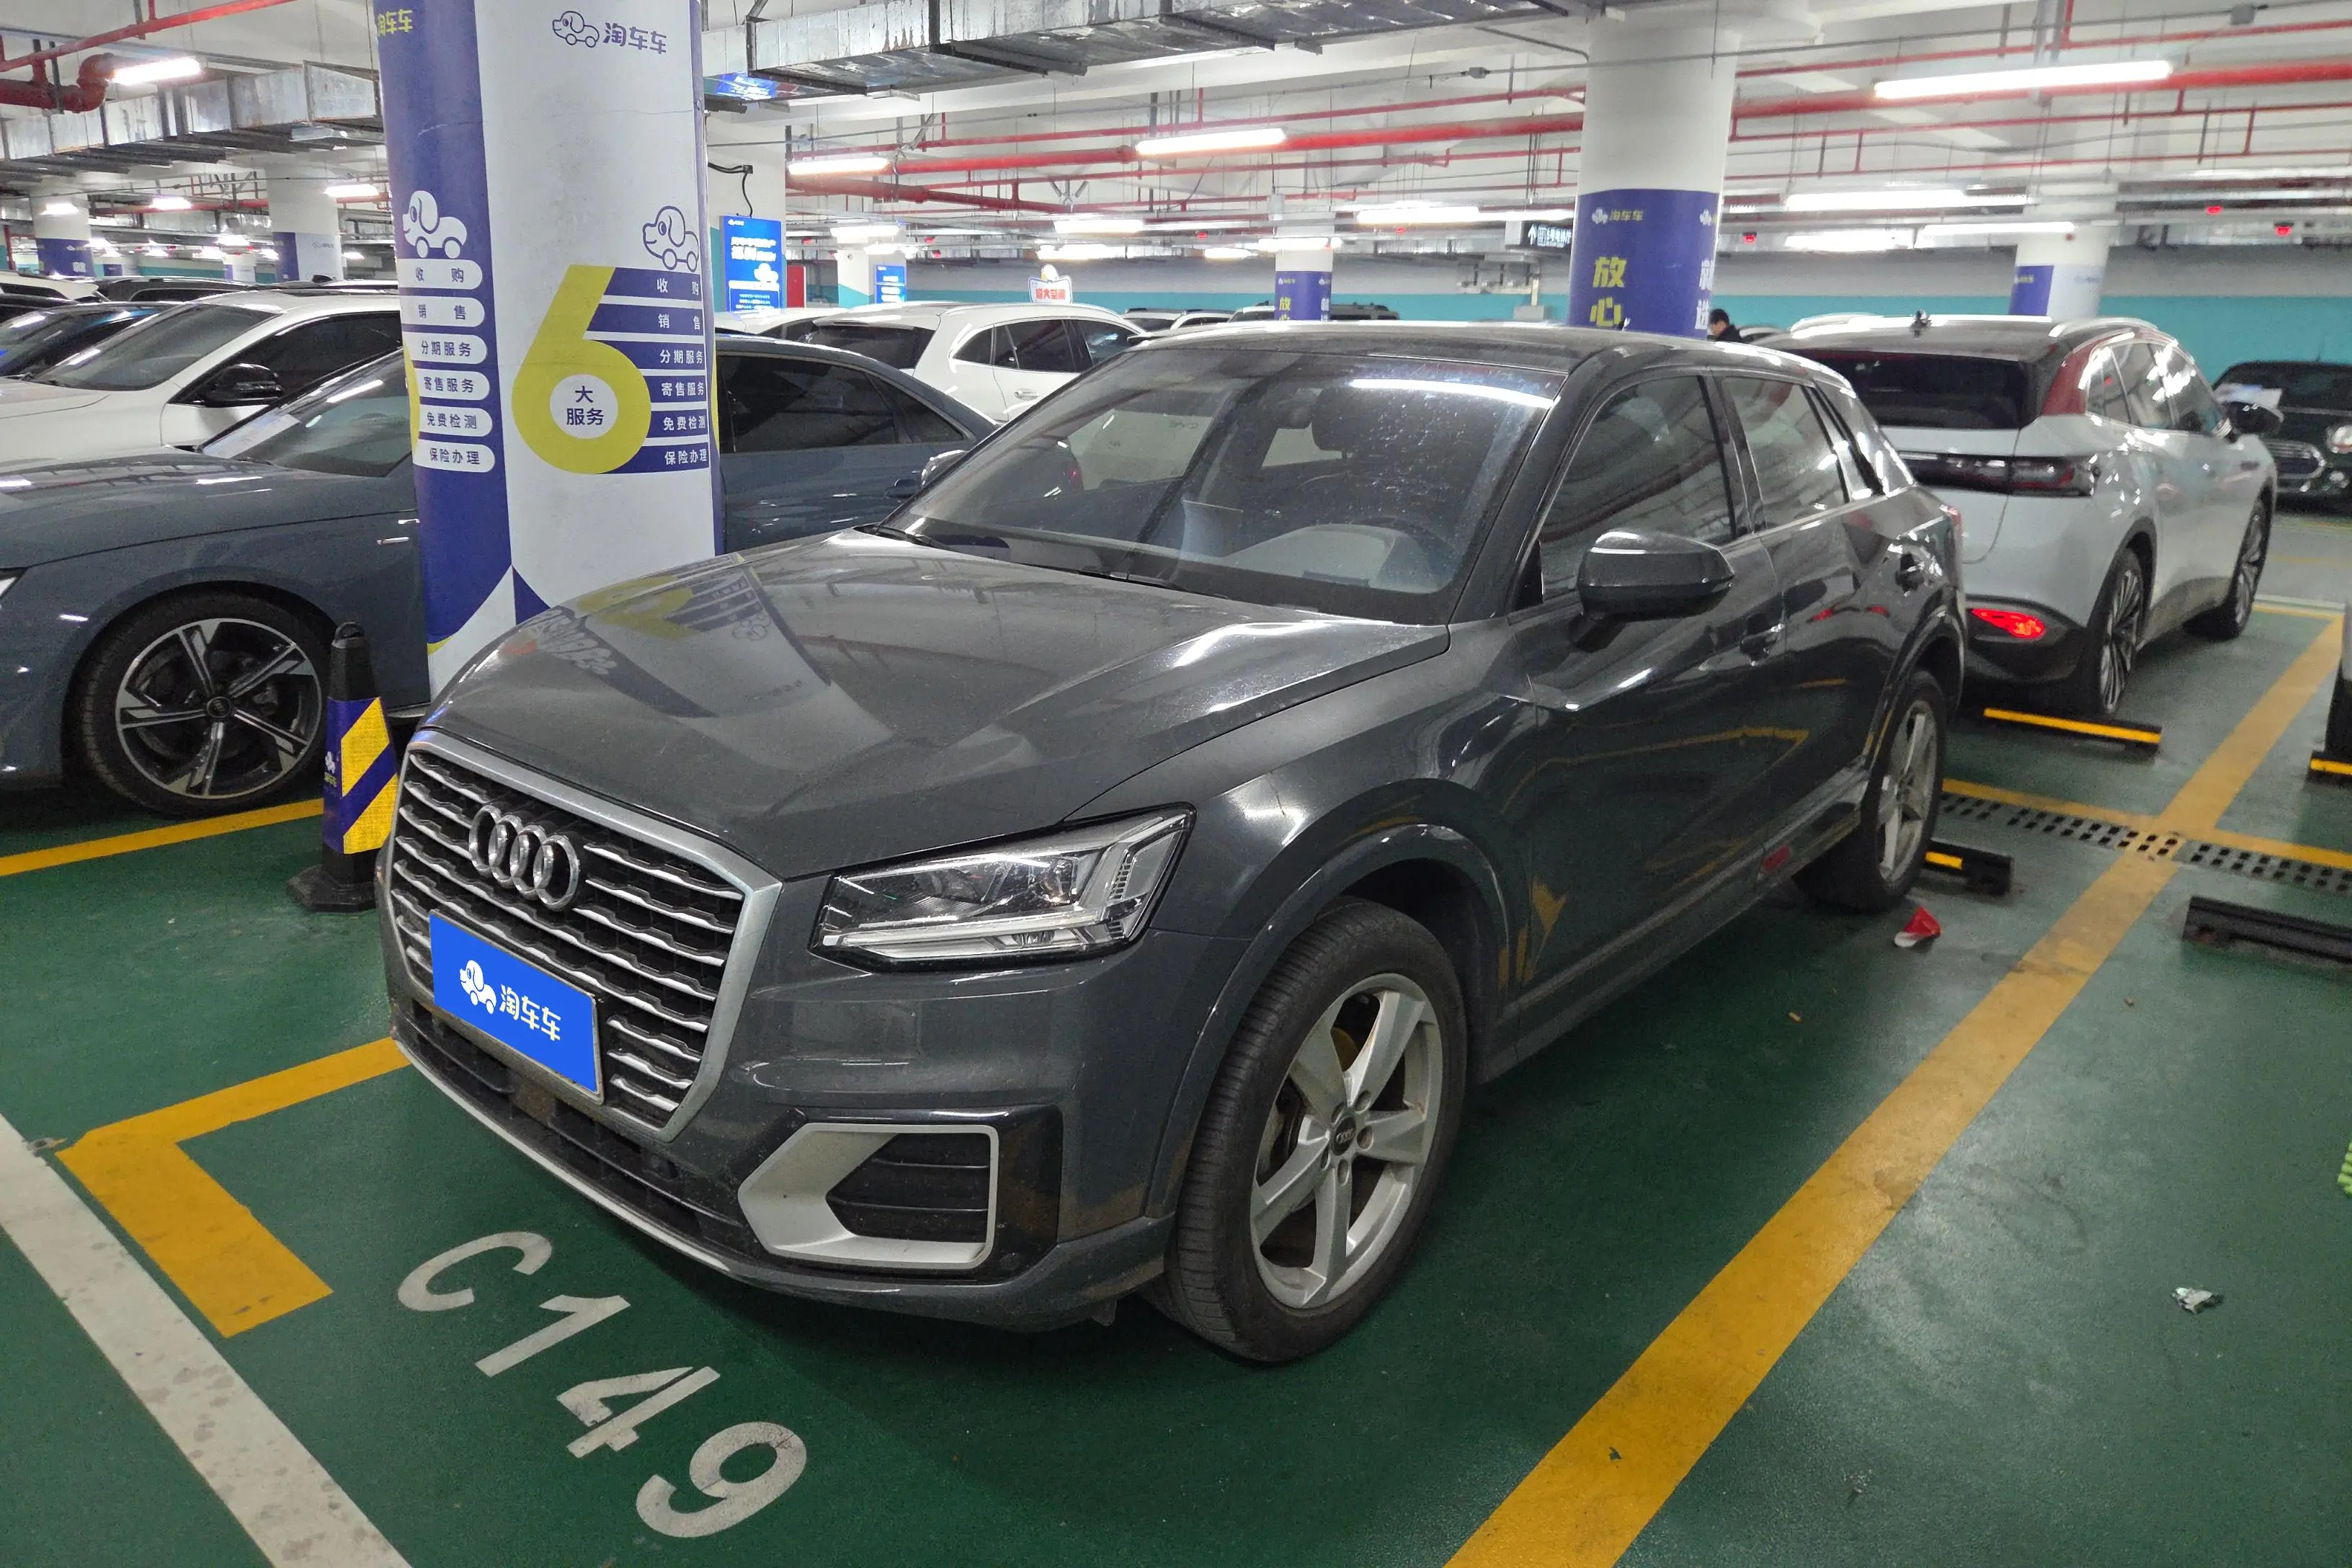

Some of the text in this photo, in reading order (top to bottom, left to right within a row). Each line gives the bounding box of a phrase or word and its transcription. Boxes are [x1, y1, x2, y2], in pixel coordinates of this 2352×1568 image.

[602, 22, 667, 55] 淘车车
[416, 267, 464, 283] 收购
[656, 278, 699, 296] 收购
[1590, 257, 1627, 328] 放心
[418, 303, 466, 321] 销售
[658, 313, 700, 330] 销售
[421, 340, 471, 357] 分期服务
[659, 349, 703, 364] 分期服务
[424, 375, 474, 393] 寄售服务
[661, 381, 704, 397] 寄售服务
[574, 385, 594, 404] 大
[427, 411, 477, 429] 免费检测
[566, 408, 604, 427] 服务
[663, 415, 706, 431] 免费检测
[429, 447, 481, 465] 保险办理
[664, 448, 708, 466] 保险办理
[398, 1231, 807, 1538] C149
